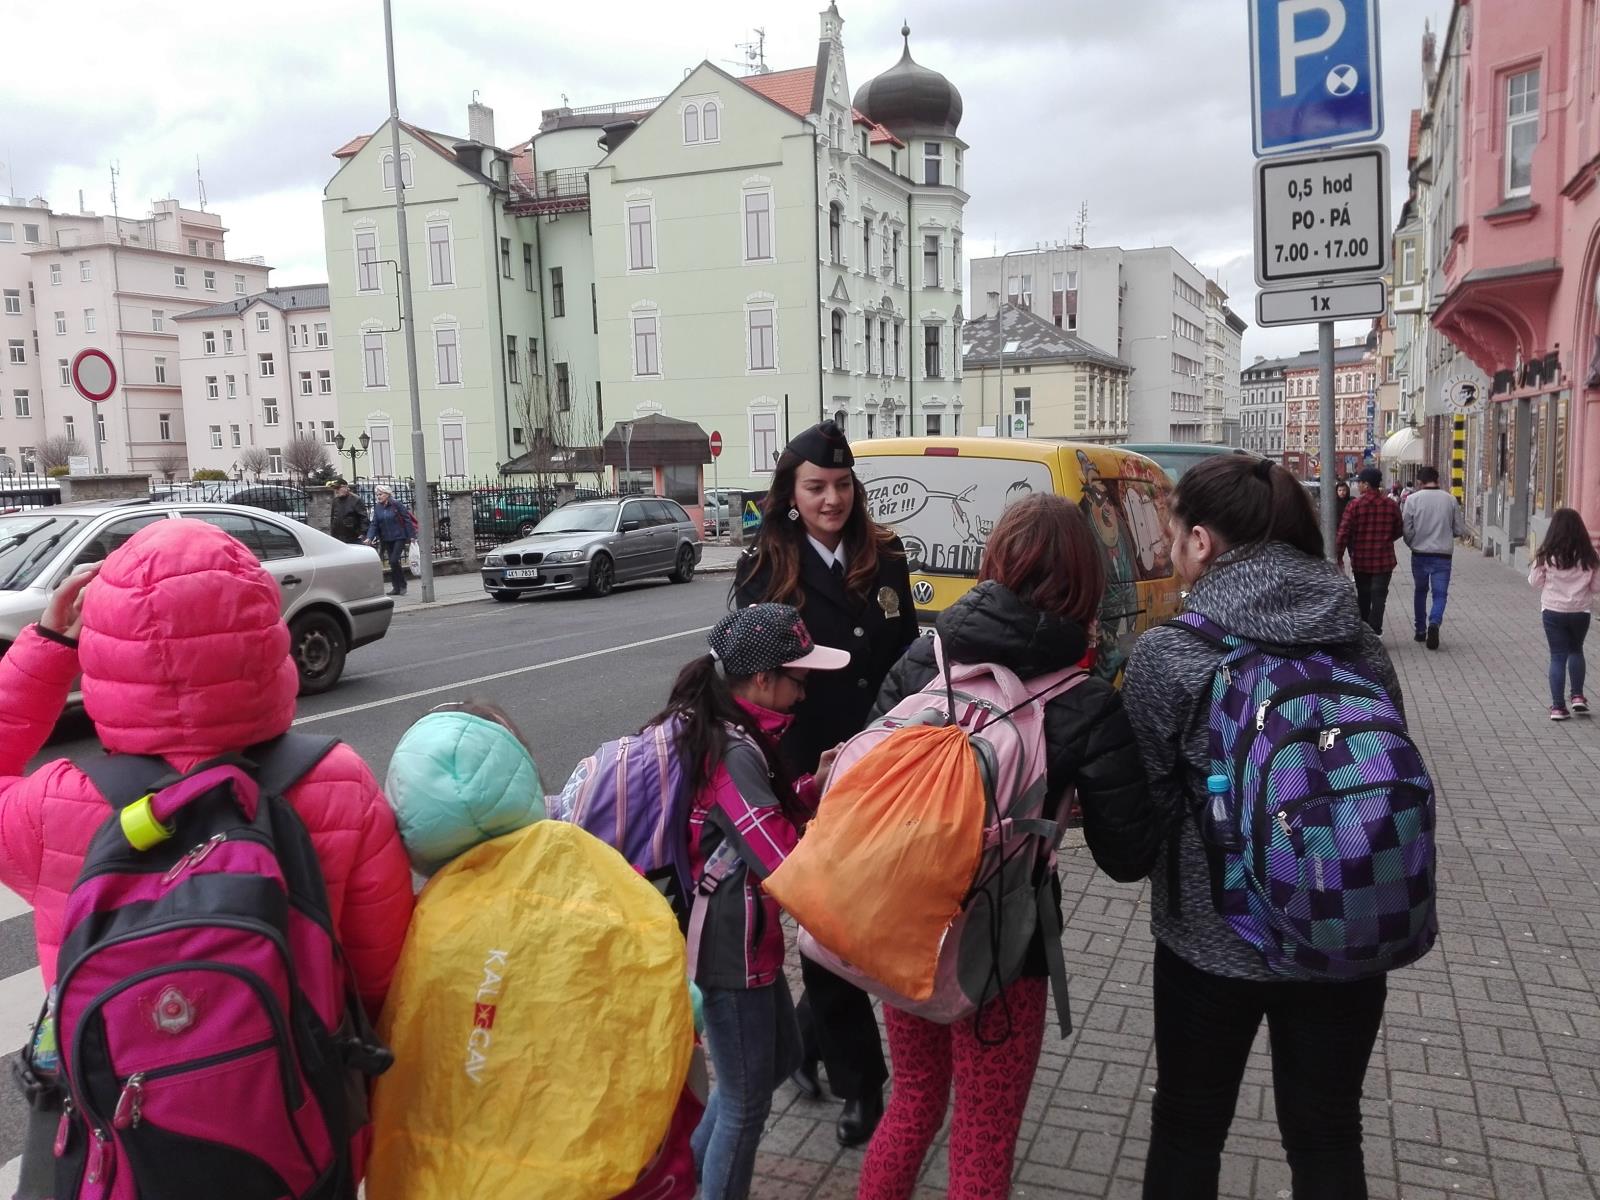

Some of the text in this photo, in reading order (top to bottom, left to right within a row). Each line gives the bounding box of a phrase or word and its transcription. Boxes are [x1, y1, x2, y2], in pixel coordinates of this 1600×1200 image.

[1278, 0, 1346, 97] P
[1288, 173, 1352, 201] 0,5 hod
[1292, 210, 1314, 230] PO
[1330, 202, 1351, 227] PÁ
[1275, 243, 1308, 262] 7.00
[1325, 238, 1368, 258] 17.00
[1311, 296, 1330, 311] 1x
[867, 483, 908, 501] ZZA CO
[879, 498, 897, 516] ŘÍZ
